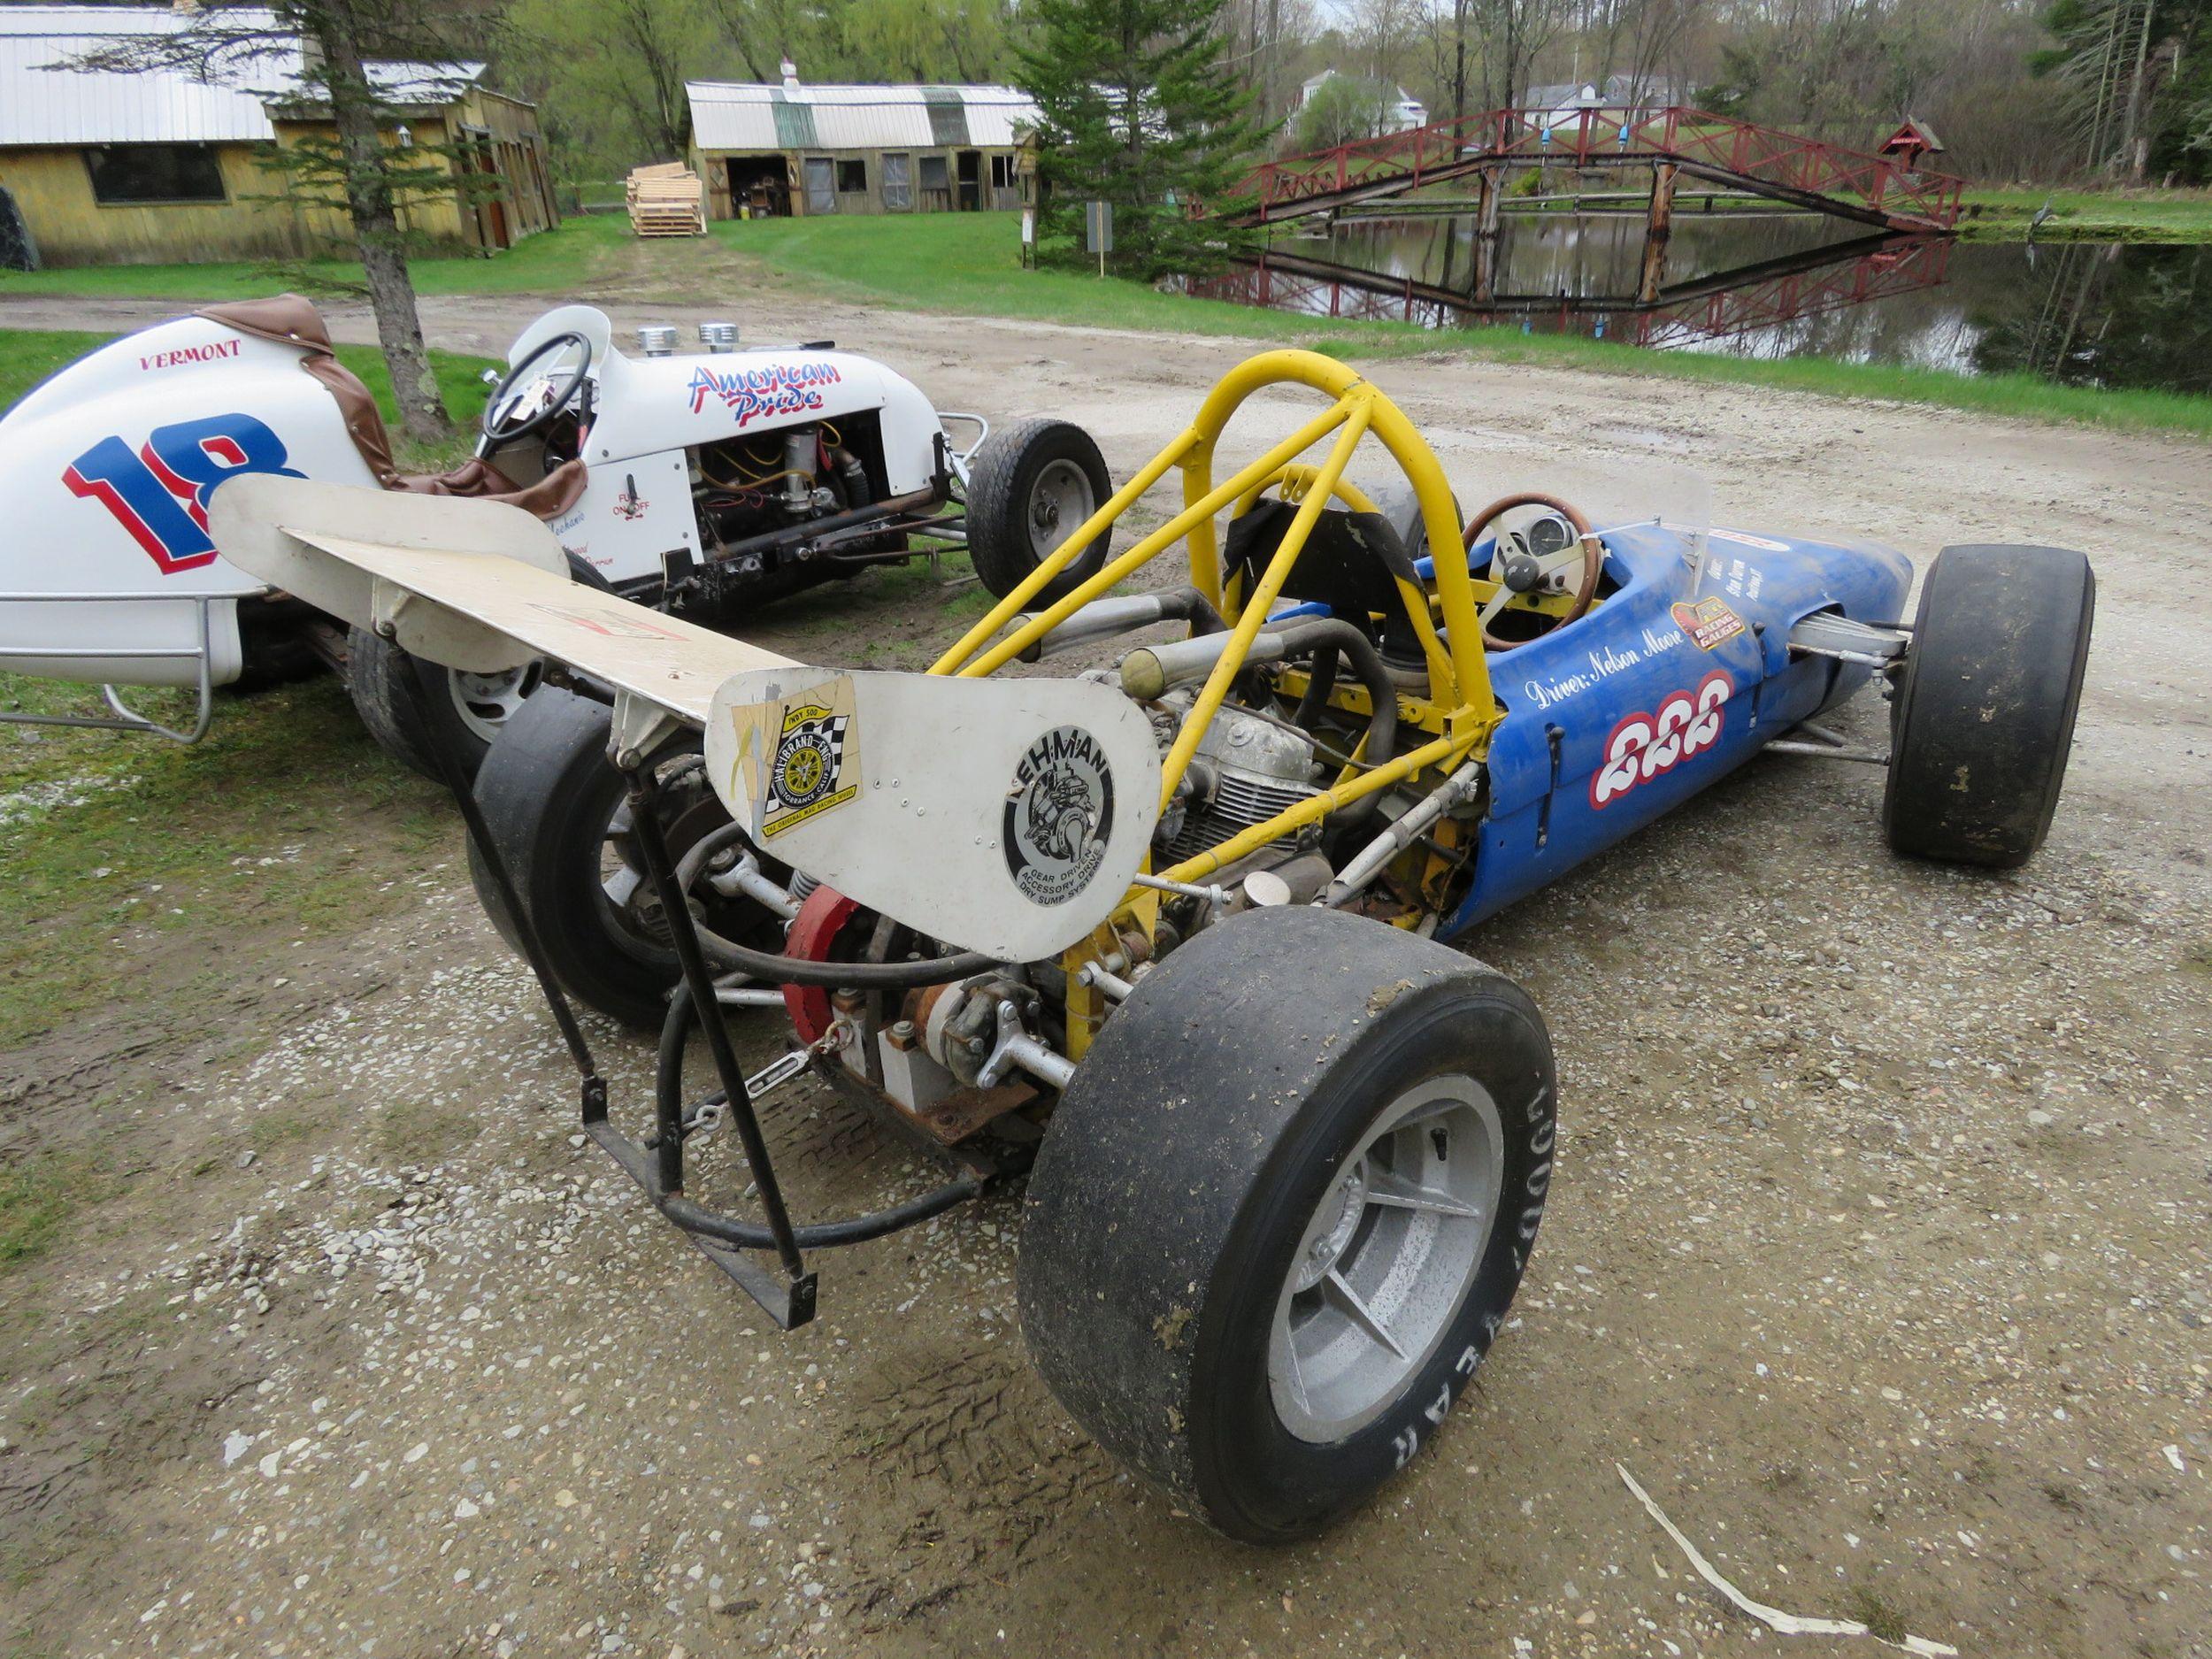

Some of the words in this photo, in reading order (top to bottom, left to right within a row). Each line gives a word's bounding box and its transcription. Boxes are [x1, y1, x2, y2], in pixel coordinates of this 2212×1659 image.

[141, 340, 242, 370] VERMONT
[687, 364, 841, 414] American
[722, 387, 824, 427] Pride
[1695, 613, 1733, 639] RACING
[1700, 619, 1741, 648] GAUGES
[1525, 673, 1592, 710] Driver:
[1589, 646, 1640, 682] Nelson
[1641, 628, 1685, 657] Moore
[787, 713, 804, 726] INDY
[1593, 673, 1732, 806] 222
[774, 734, 814, 783] HALIBRAND
[818, 741, 832, 764] ENG
[1012, 729, 1106, 792] EHMAN
[783, 793, 816, 805] TORRANCE
[1019, 881, 1037, 899] DRY
[1037, 894, 1065, 905] SUMP
[1068, 853, 1104, 898] SYSTEMS
[1021, 872, 1075, 895] ACCESSORY
[1078, 848, 1102, 880] DRIVE
[1031, 868, 1056, 883] GEAR
[1060, 848, 1093, 881] DRIVEN
